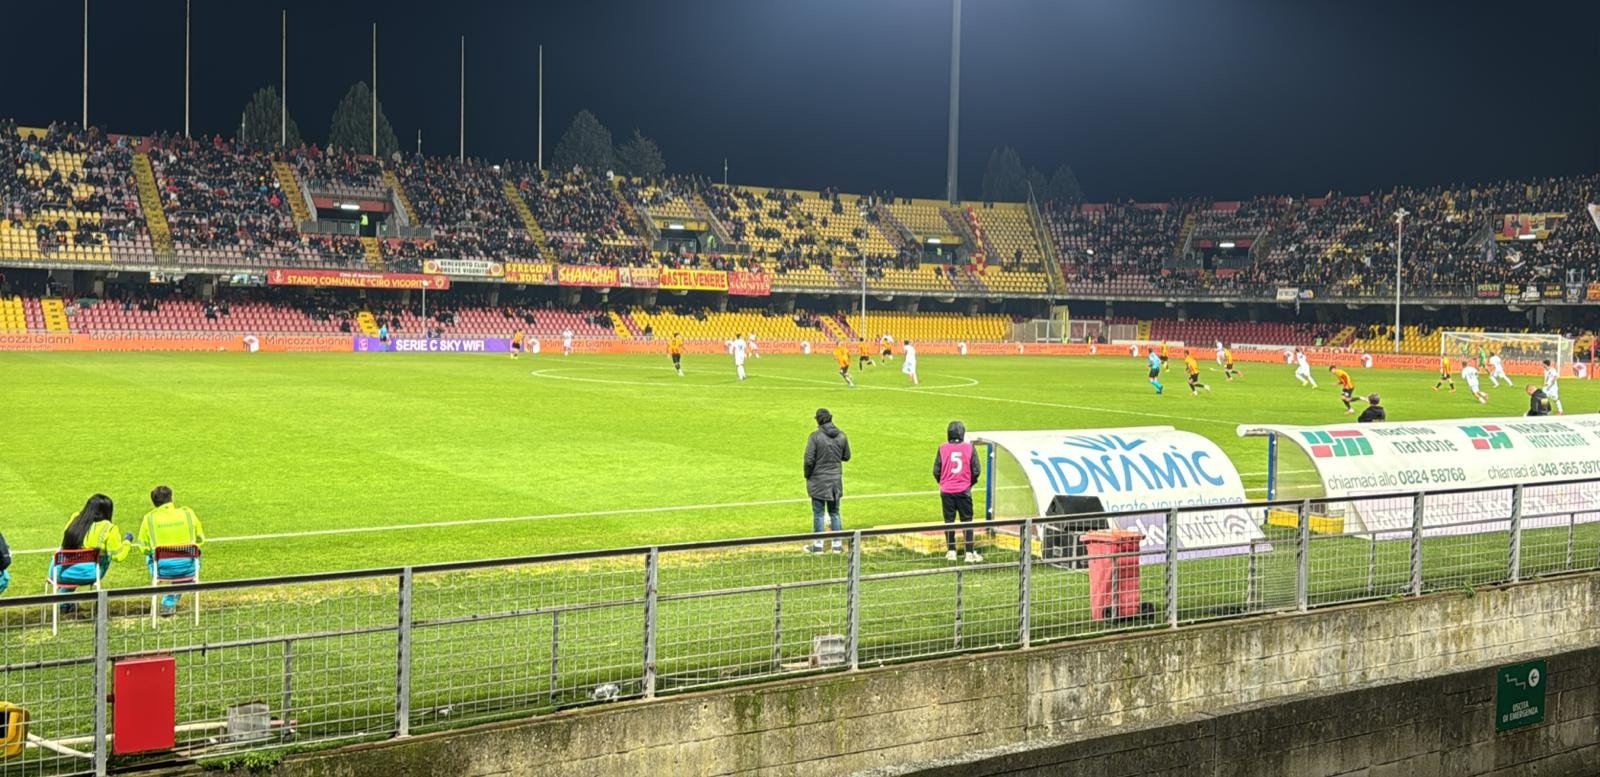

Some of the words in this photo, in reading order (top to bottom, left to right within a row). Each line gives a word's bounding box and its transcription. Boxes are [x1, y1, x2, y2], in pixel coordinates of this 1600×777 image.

[440, 260, 473, 268] BENEVENTO
[287, 276, 317, 285] STADIO
[319, 277, 366, 287] COMUNALE
[367, 278, 390, 287] "CIRO
[559, 266, 618, 285] SHANGHAI
[35, 335, 75, 345] Gianni
[265, 336, 314, 346] Minicozzi
[316, 337, 351, 346] Gianni
[396, 339, 424, 351] SERIE
[429, 340, 438, 351] C
[439, 340, 461, 351] SKY
[463, 340, 485, 351] WIFI
[1376, 354, 1413, 364] Minicozzi
[1415, 356, 1441, 366] Giann
[1391, 437, 1459, 454] nardone
[950, 451, 963, 474] 5
[1487, 464, 1528, 480] chiamaci
[1529, 463, 1538, 476] al
[1538, 462, 1559, 477] 348
[1559, 461, 1579, 476] 365
[1328, 472, 1376, 491] chiamaci
[1379, 470, 1398, 487] allo
[1398, 469, 1430, 486] 0824
[1432, 467, 1467, 483] 58768
[1178, 515, 1226, 541] wifi
